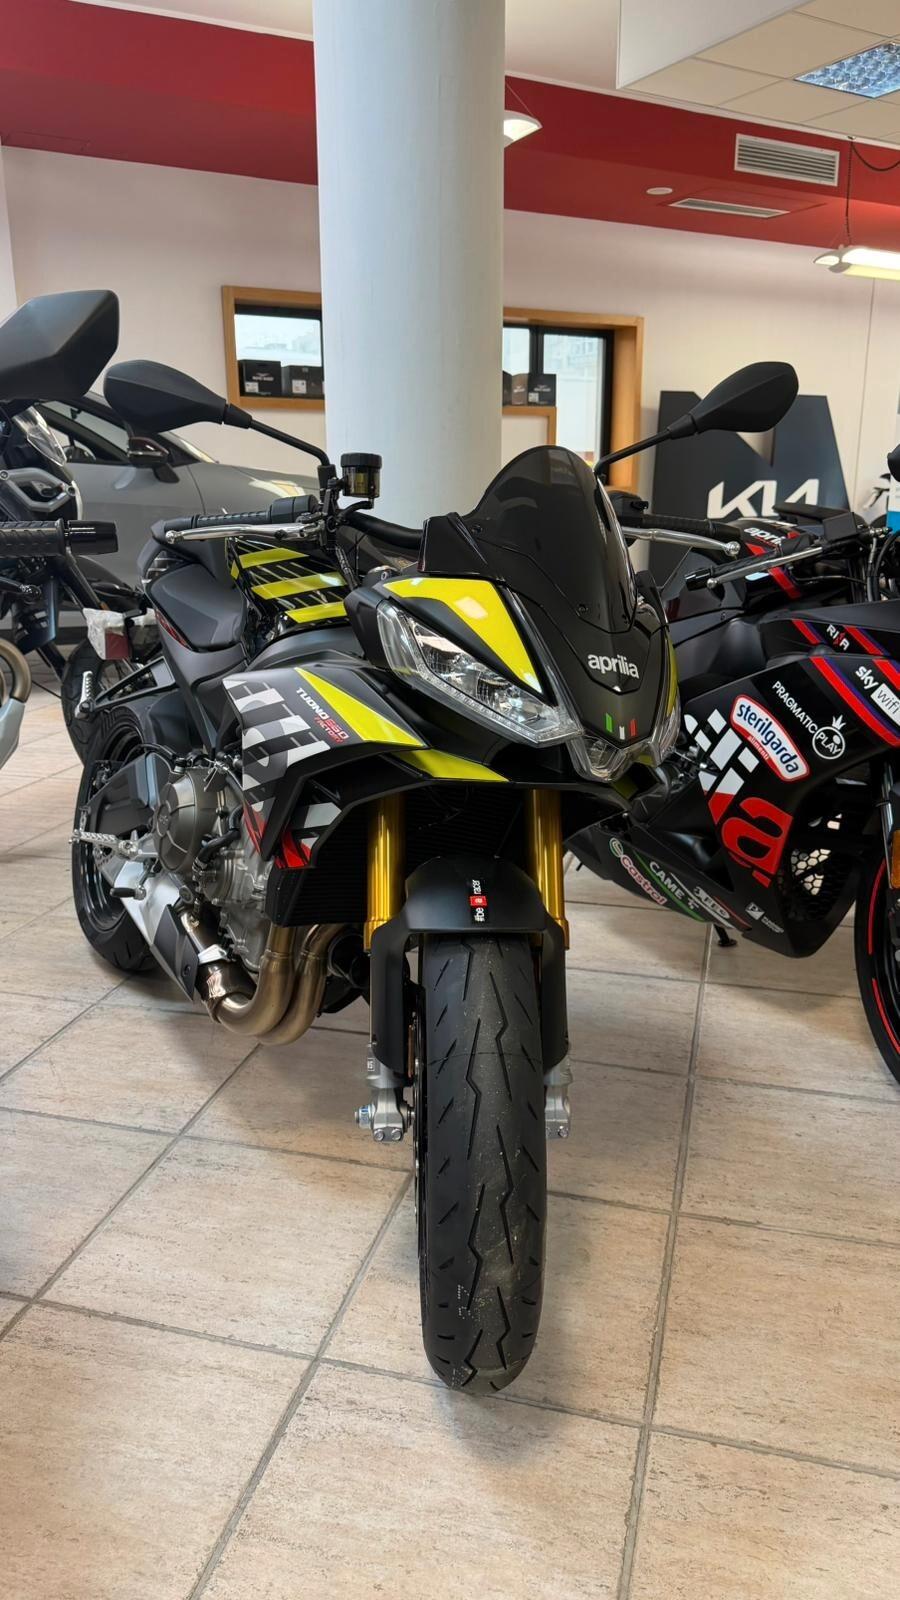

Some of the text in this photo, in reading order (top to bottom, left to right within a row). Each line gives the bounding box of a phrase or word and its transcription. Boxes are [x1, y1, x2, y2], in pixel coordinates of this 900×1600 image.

[707, 478, 820, 519] KIA
[587, 654, 640, 679] aprilia
[855, 666, 879, 690] sky
[296, 687, 329, 720] TUONO
[771, 680, 843, 755] PRAGMATIC PLAY
[737, 704, 799, 773] sterilgarda
[620, 854, 668, 905] Castrol
[649, 861, 686, 900] CAME
